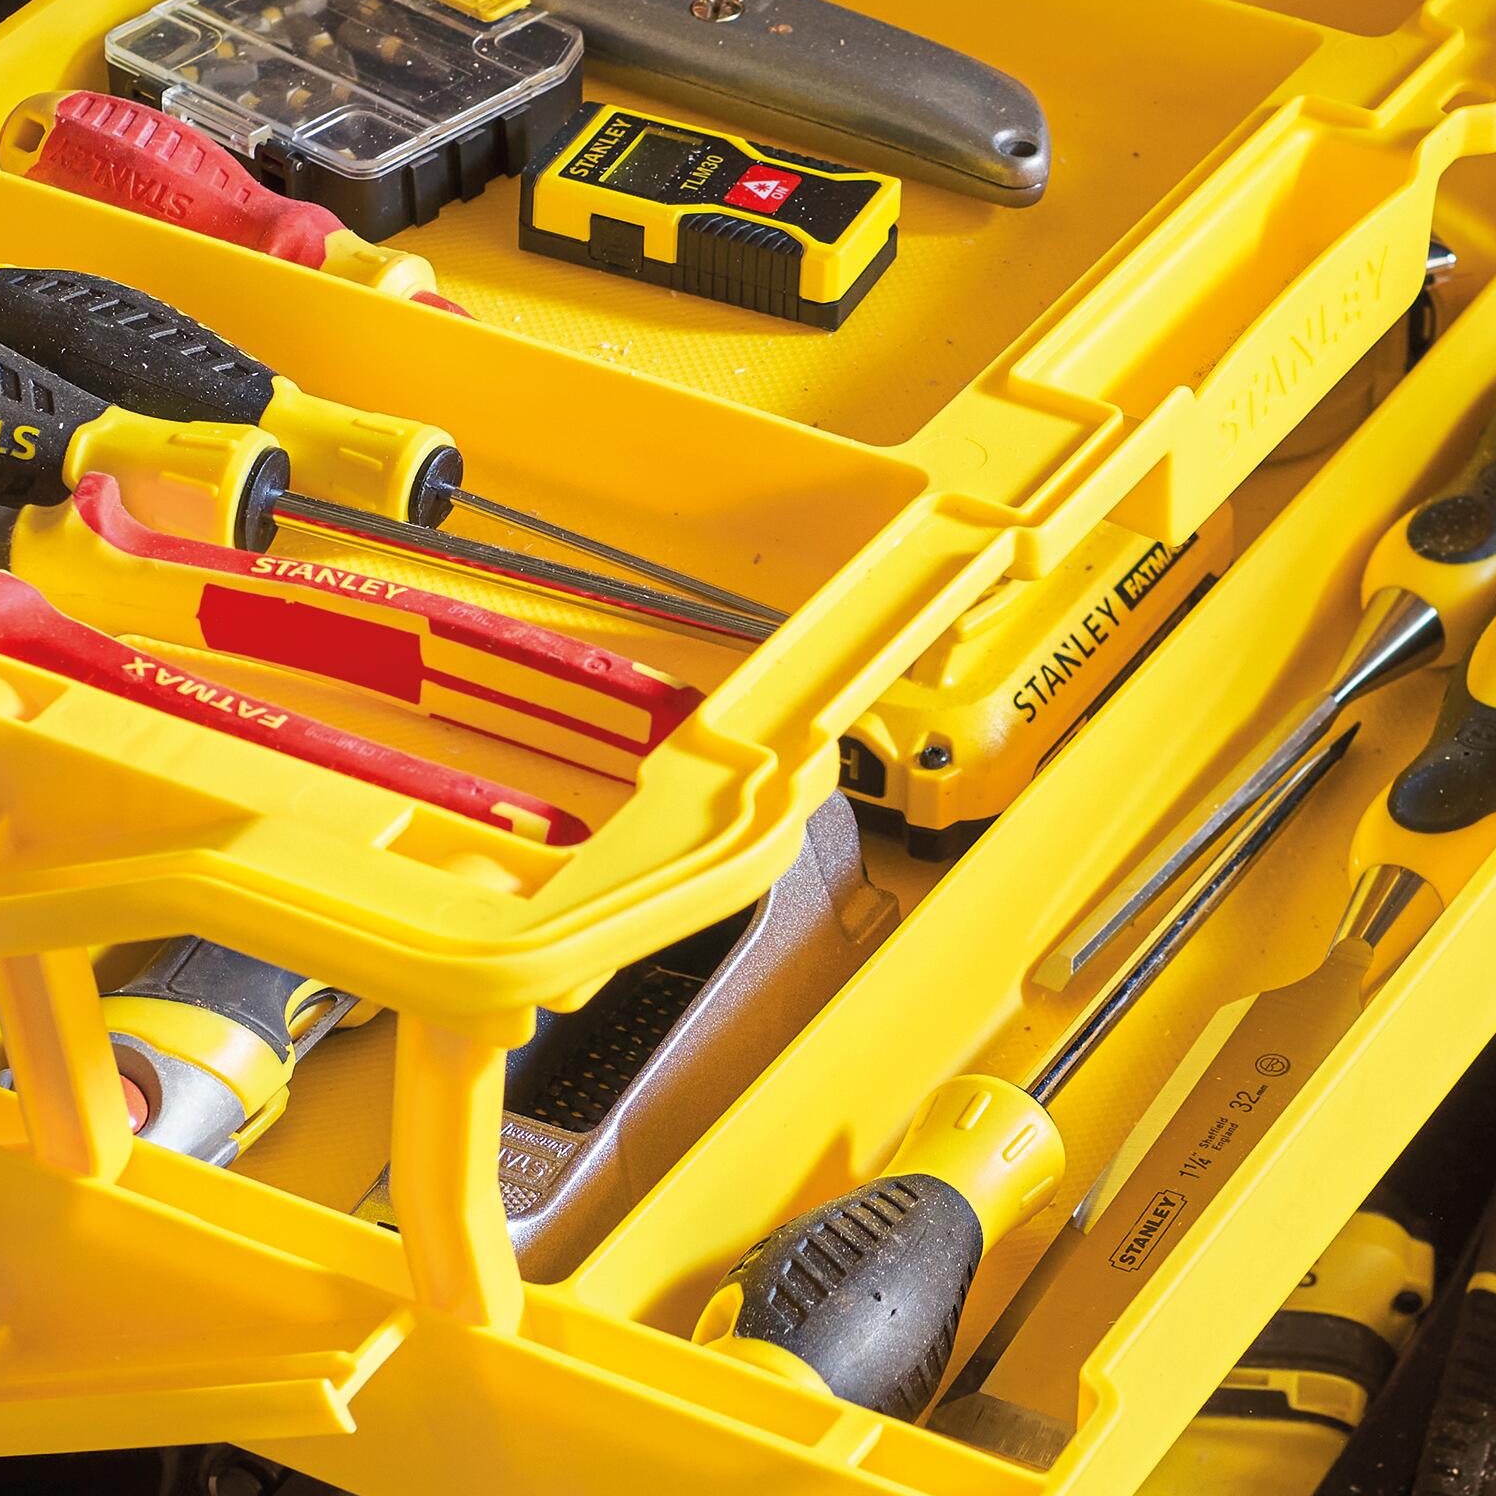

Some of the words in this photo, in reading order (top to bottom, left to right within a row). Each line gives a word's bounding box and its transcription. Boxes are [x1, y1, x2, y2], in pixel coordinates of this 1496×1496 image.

[569, 116, 633, 179] STANLEY
[679, 154, 725, 192] TLM30
[772, 185, 791, 202] ON
[1221, 245, 1389, 442] STANLEY
[250, 555, 409, 602] STANLEY
[1012, 596, 1120, 724] STANLEY
[1122, 542, 1187, 601] FATM
[121, 656, 289, 730] FATMAX
[1198, 1116, 1229, 1149] Sheffield
[1211, 1121, 1240, 1151] England
[1119, 1195, 1178, 1267] STANLEY
